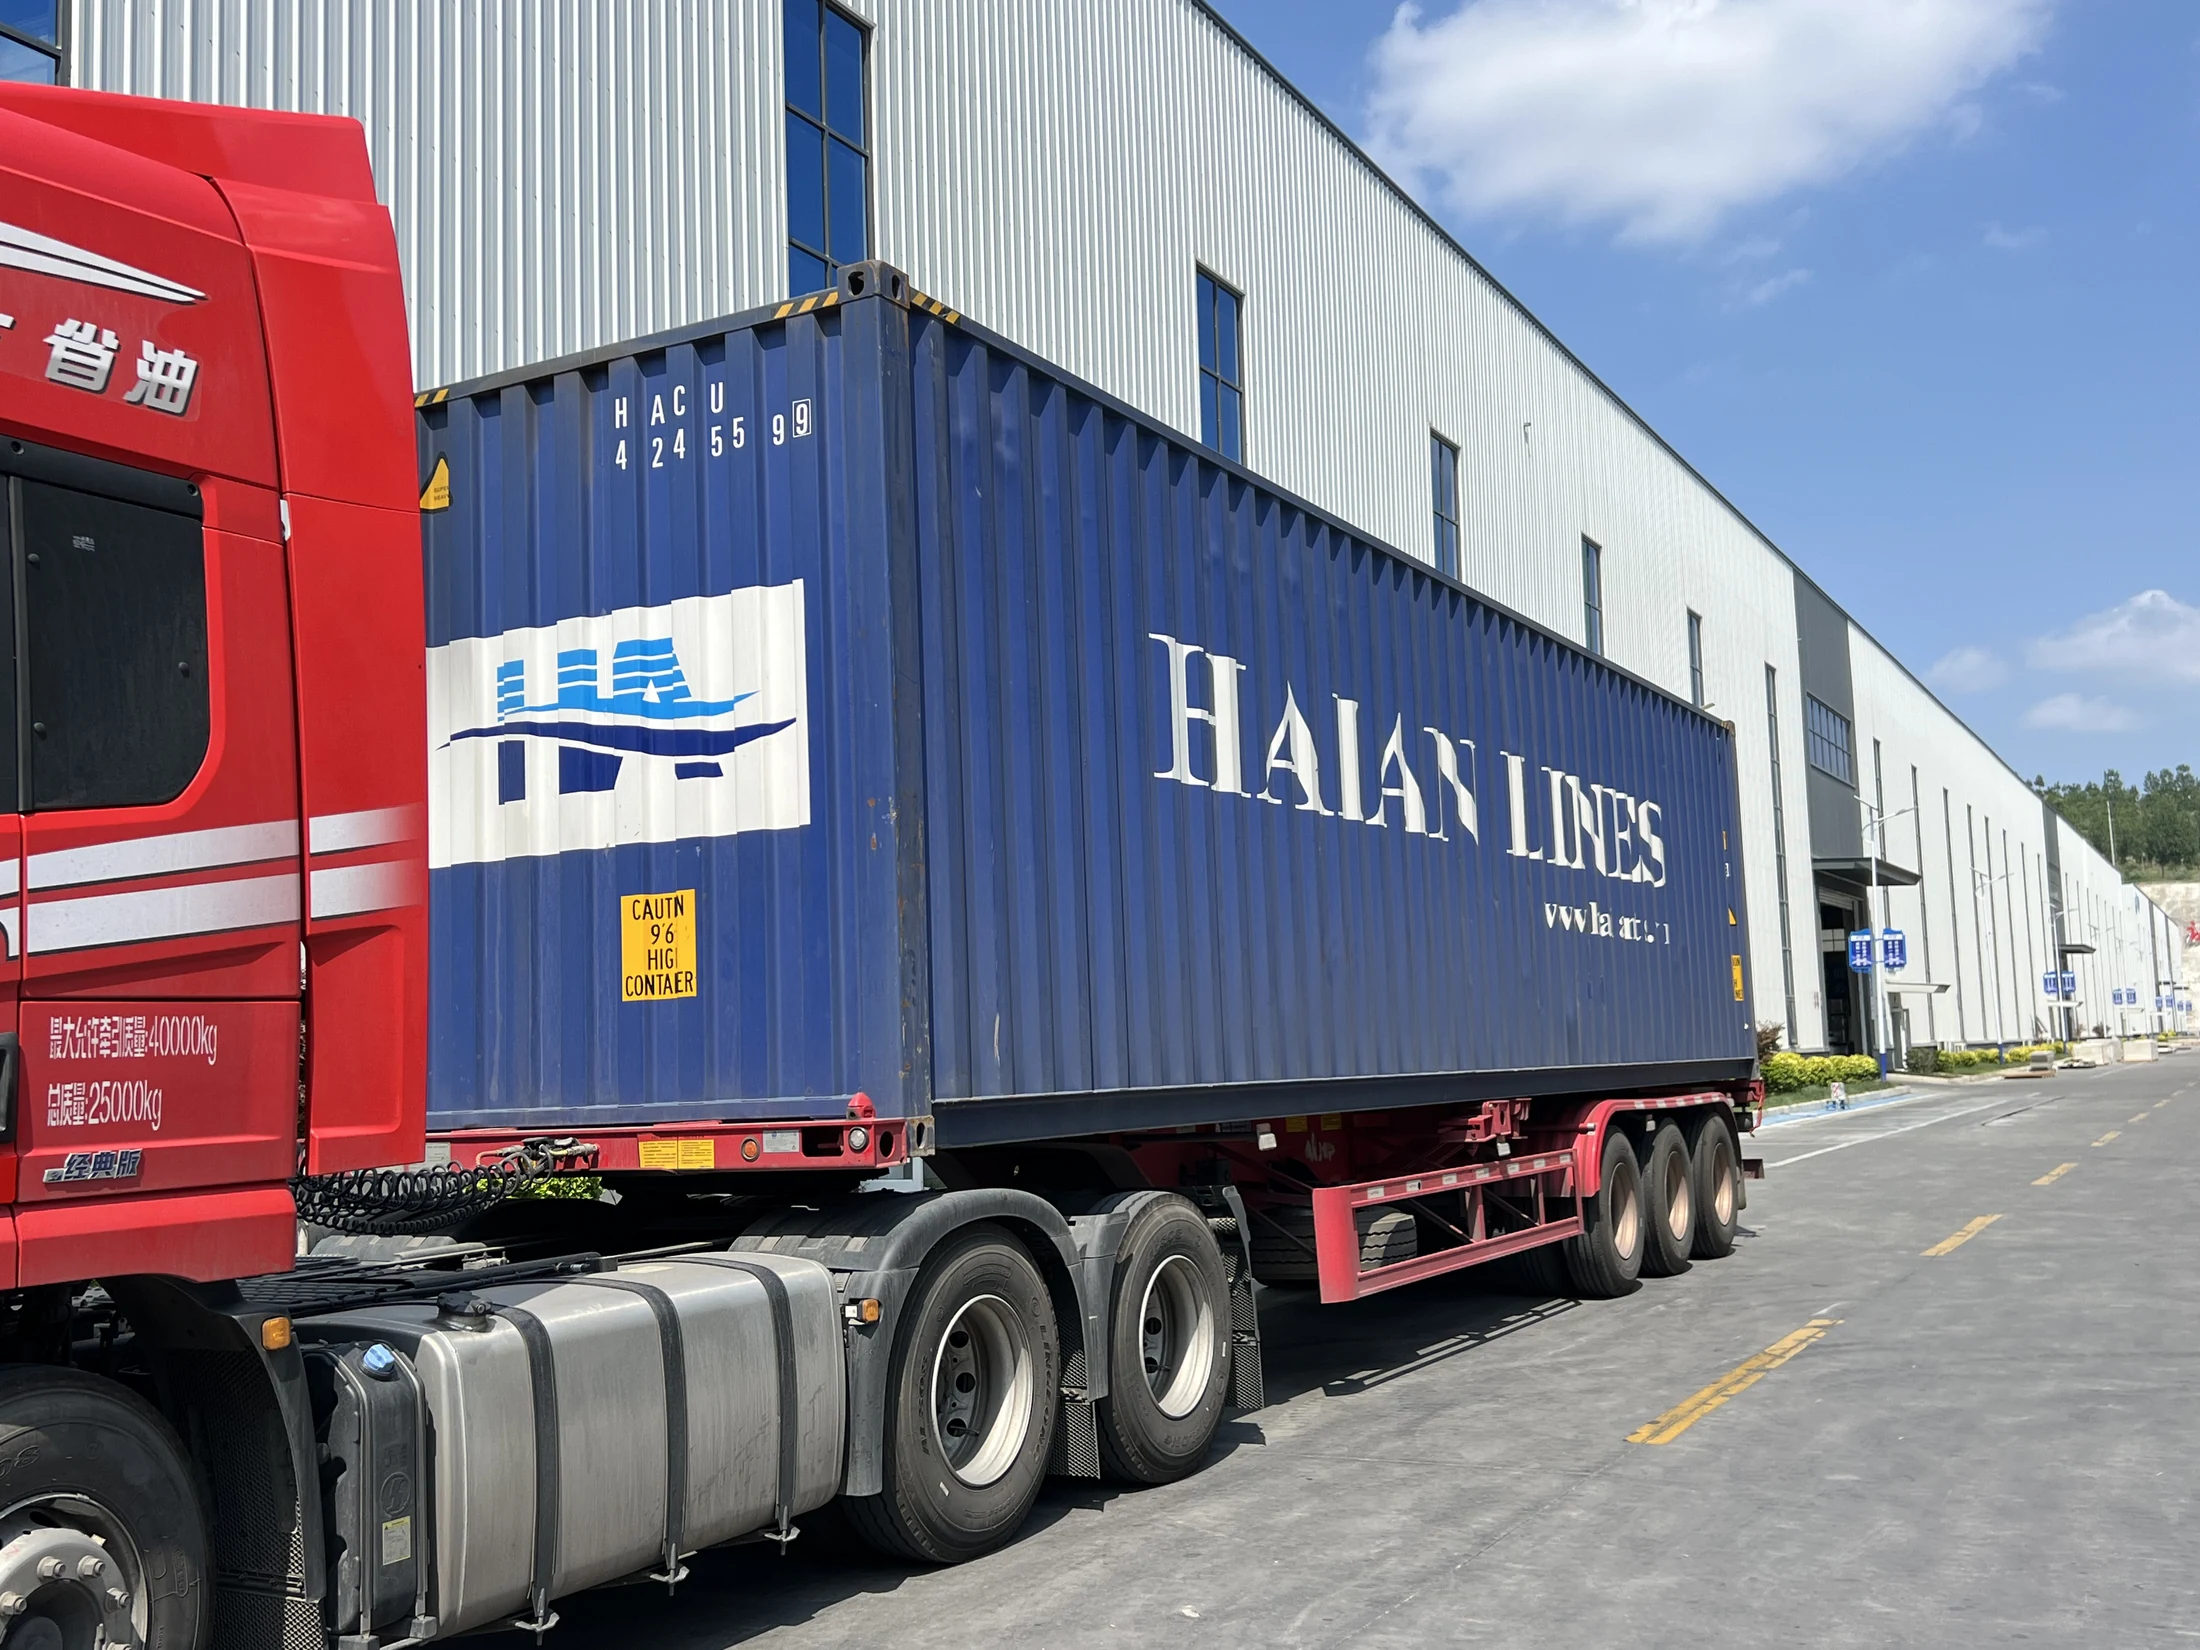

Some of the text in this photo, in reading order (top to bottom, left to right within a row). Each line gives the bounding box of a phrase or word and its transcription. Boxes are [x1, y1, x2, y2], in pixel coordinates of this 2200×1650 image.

[0, 313, 198, 415] 省油
[614, 381, 724, 429] HACU
[1148, 633, 1667, 888] HAIAN LINES
[647, 948, 678, 970] HIG
[63, 1148, 143, 1180] 经典版
